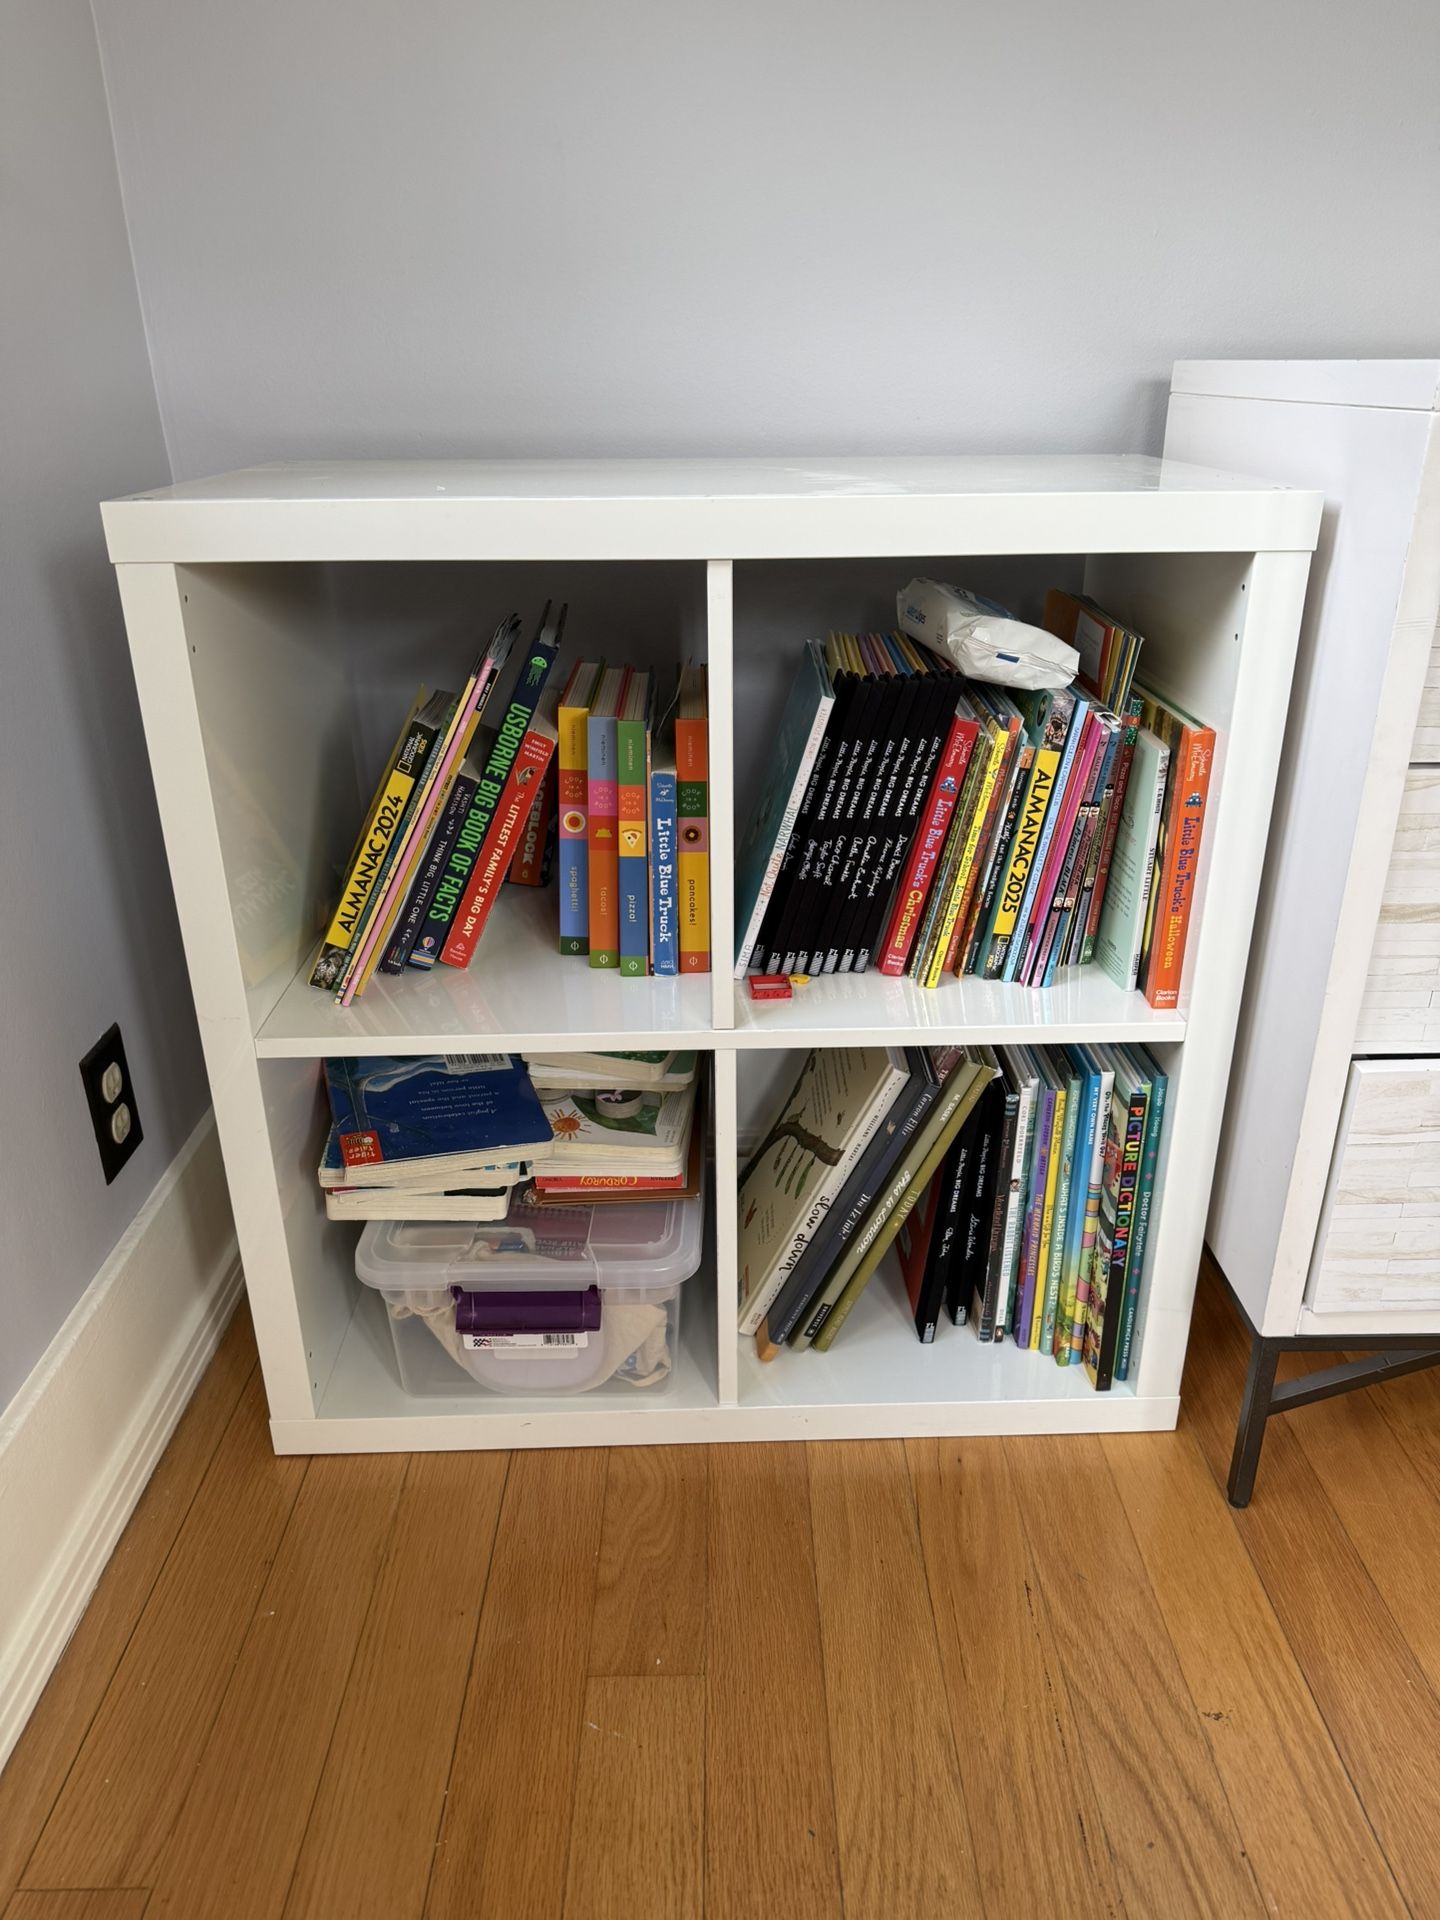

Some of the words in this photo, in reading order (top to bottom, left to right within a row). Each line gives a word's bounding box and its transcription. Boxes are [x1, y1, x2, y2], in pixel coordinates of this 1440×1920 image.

[400, 736, 416, 761] NATIONAL
[405, 731, 424, 764] GEOGRAPHIC
[484, 701, 532, 780] USBORNE
[1093, 755, 1101, 771] HALE
[1119, 761, 1128, 779] Pizza
[809, 773, 819, 786] BIG
[825, 778, 836, 792] BIG
[1087, 776, 1096, 793] PHAM
[447, 785, 465, 815] HARRISON
[473, 778, 500, 808] BIG
[513, 790, 525, 804] The
[800, 786, 815, 814] DREAMS
[817, 792, 832, 821] DREAMS
[930, 797, 952, 828] Little
[1012, 767, 1052, 870] ALMANAC
[455, 807, 489, 853] BOOK
[495, 803, 520, 847] LITTLEST
[773, 804, 798, 851] NARWHAL
[970, 824, 980, 843] Time
[1181, 815, 1200, 846] Little
[656, 818, 671, 859] Little
[816, 837, 832, 861] Taylor
[832, 834, 846, 855] Coco
[923, 826, 943, 850] Blue
[967, 843, 975, 854] for
[333, 838, 387, 933] ALMANAC
[371, 792, 405, 840] 2024
[431, 839, 447, 863] THINK
[447, 851, 471, 874] OF
[995, 854, 1003, 864] the
[1146, 847, 1155, 875] STUART
[1177, 847, 1194, 871] Blue
[424, 863, 437, 880] BIG,
[477, 847, 503, 894] FAMILY'S
[765, 850, 784, 880] Quite
[811, 860, 825, 879] Swift
[823, 854, 840, 886] Chanel
[911, 848, 936, 889] Truck's
[965, 865, 977, 889] Makes
[988, 864, 1000, 890] Moonlight
[569, 866, 578, 911] spaghetti!
[658, 864, 671, 895] Blue
[759, 880, 773, 897] Not
[1001, 870, 1025, 914] 2025
[1142, 877, 1150, 901] LITTLE
[1170, 871, 1190, 913] Truck's
[414, 880, 430, 905] LITTLE
[428, 873, 463, 923] FACTS
[469, 894, 484, 915] BIG
[600, 887, 608, 915] tacos!
[687, 879, 697, 925] pancakes!
[952, 884, 964, 902] Little
[984, 890, 993, 908] Rescue
[407, 905, 420, 924] ONE
[627, 894, 636, 922] pizza!
[658, 896, 671, 942] Truck
[893, 888, 924, 950] Christmas
[948, 902, 959, 916] Blue
[957, 894, 969, 919] Friend
[460, 915, 476, 937] DAY
[942, 916, 954, 937] Truck
[1163, 914, 1183, 969] Halloween
[738, 943, 753, 967] SIMA
[1132, 952, 1140, 975] HARPER
[951, 1092, 960, 1102] M.
[1092, 1086, 1099, 1095] MY
[1155, 1087, 1164, 1106] Jacob
[911, 1092, 932, 1119] Carson
[938, 1101, 955, 1122] SASEK
[1090, 1097, 1098, 1112] VERY
[900, 1117, 918, 1138] Ellis
[1122, 1105, 1144, 1172] PICTURE
[1150, 1116, 1161, 1137] Hoang
[349, 1151, 376, 1159] tiger
[891, 1169, 913, 1197] This
[855, 1192, 871, 1209] Du
[883, 1195, 896, 1209] is
[896, 1188, 920, 1220] TODAY
[1008, 1206, 1016, 1215] THE
[1034, 1193, 1043, 1206] THE
[1139, 1191, 1151, 1219] Doctor
[803, 1194, 833, 1232] slow
[848, 1207, 861, 1220] Iz
[1030, 1207, 1041, 1238] MERMAID
[1111, 1176, 1135, 1266] DICTIONARY
[855, 1207, 889, 1256] London
[1005, 1221, 1015, 1244] RABBIT
[1133, 1221, 1146, 1256] Fairytale
[777, 1231, 810, 1275] down
[1002, 1246, 1012, 1276] LISTENED
[1026, 1239, 1038, 1276] PRINCESSES
